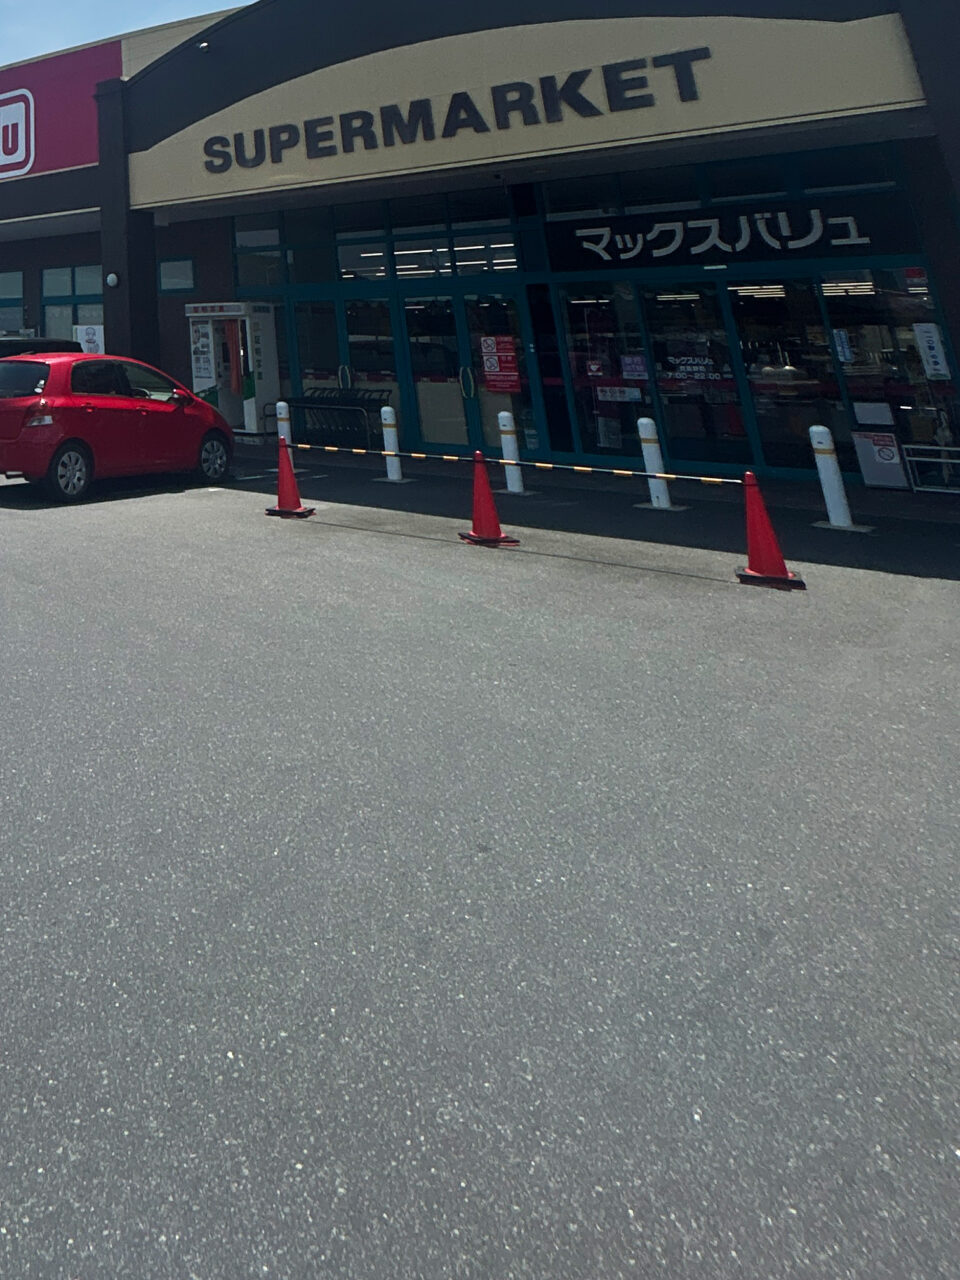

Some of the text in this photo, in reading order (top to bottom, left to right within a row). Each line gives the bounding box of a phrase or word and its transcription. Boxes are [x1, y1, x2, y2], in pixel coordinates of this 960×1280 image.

[203, 46, 712, 174] SUPERMARKET
[575, 209, 871, 261] マックスバリュ
